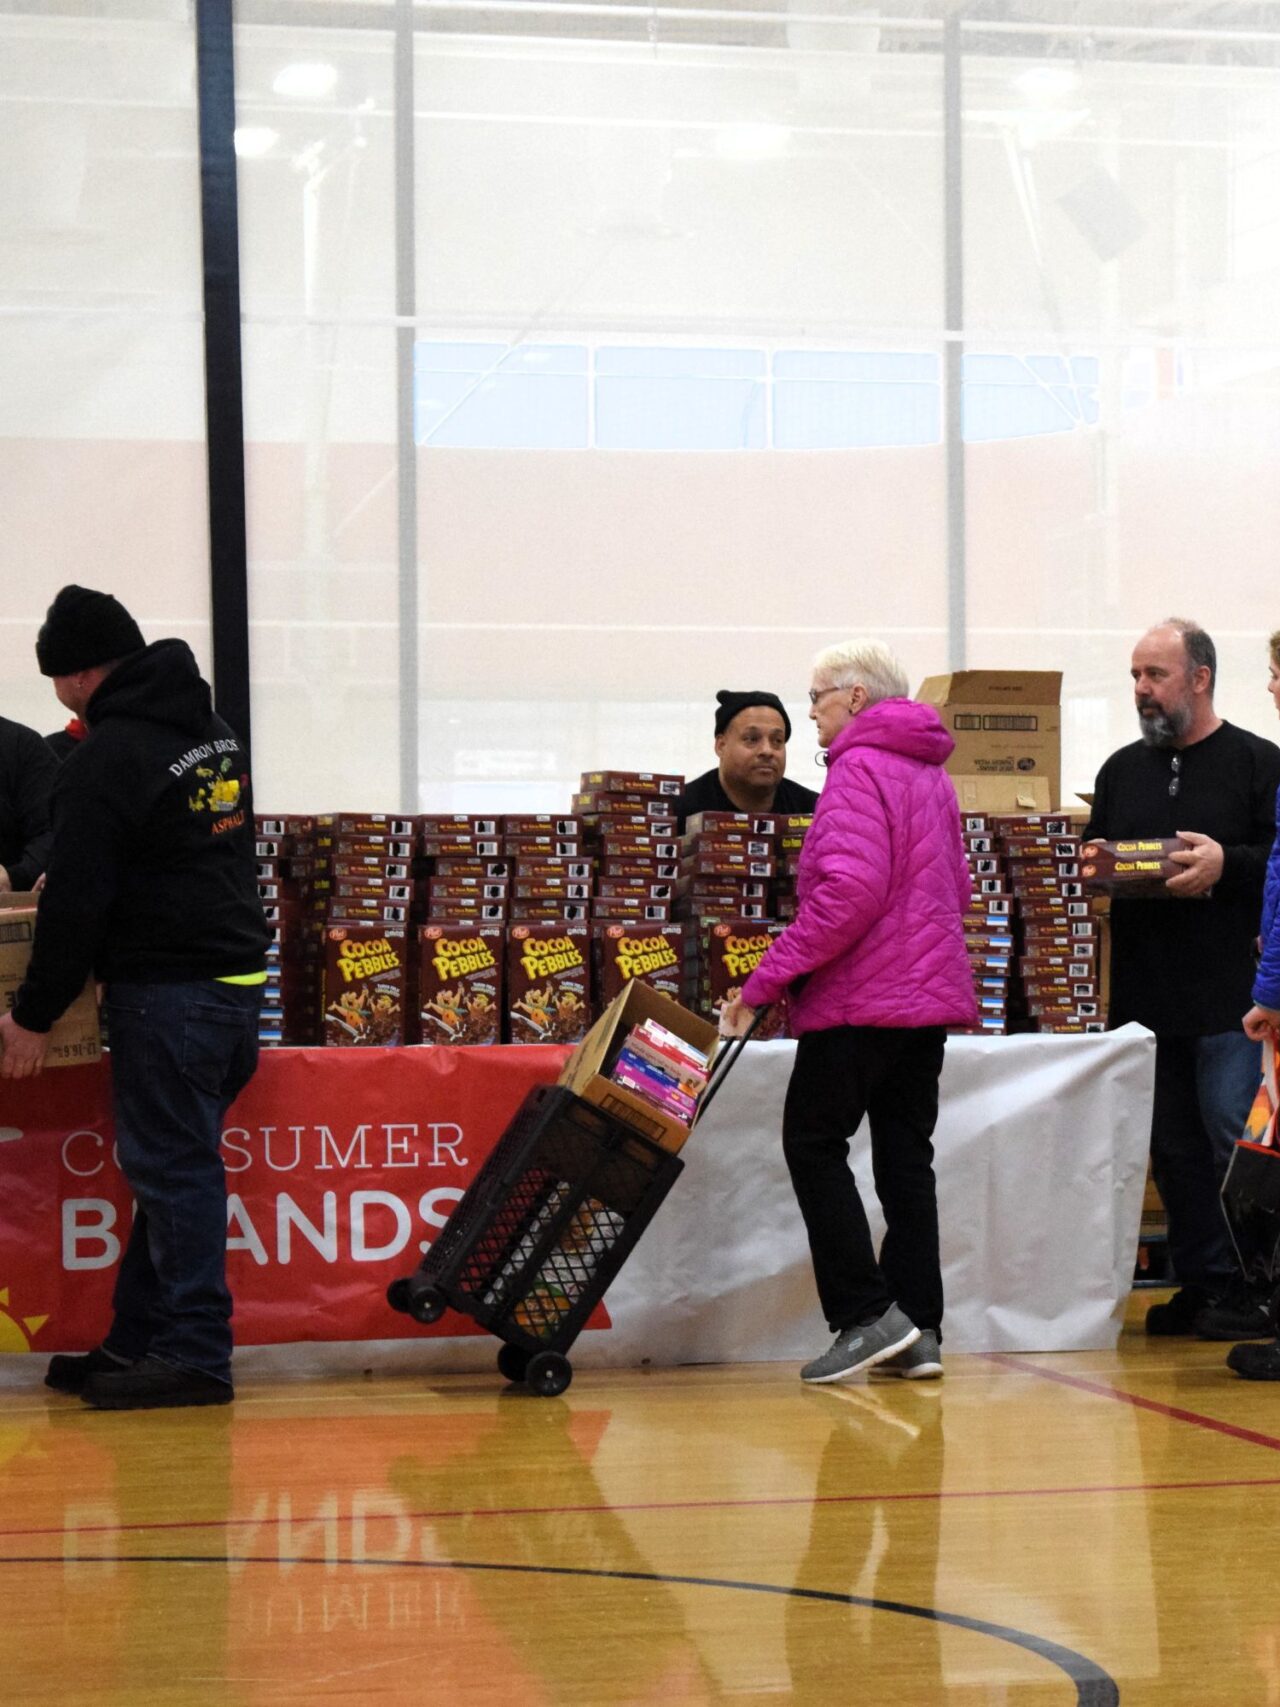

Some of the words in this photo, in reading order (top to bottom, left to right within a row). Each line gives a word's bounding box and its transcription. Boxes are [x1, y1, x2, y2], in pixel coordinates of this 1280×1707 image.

[168, 743, 215, 777] DAMRON
[340, 938, 392, 958] COCOA
[435, 937, 487, 957] COCOA
[523, 936, 575, 957] COCOA
[618, 935, 670, 956] COCOA
[725, 934, 774, 954] COCOA
[337, 952, 400, 982] PEBBLES
[432, 951, 495, 981] PEBBLES
[520, 950, 583, 980] PEBBLES
[615, 949, 677, 979] PEBBLES
[62, 1122, 469, 1177] CSUMER
[62, 1186, 467, 1272] BANDS
